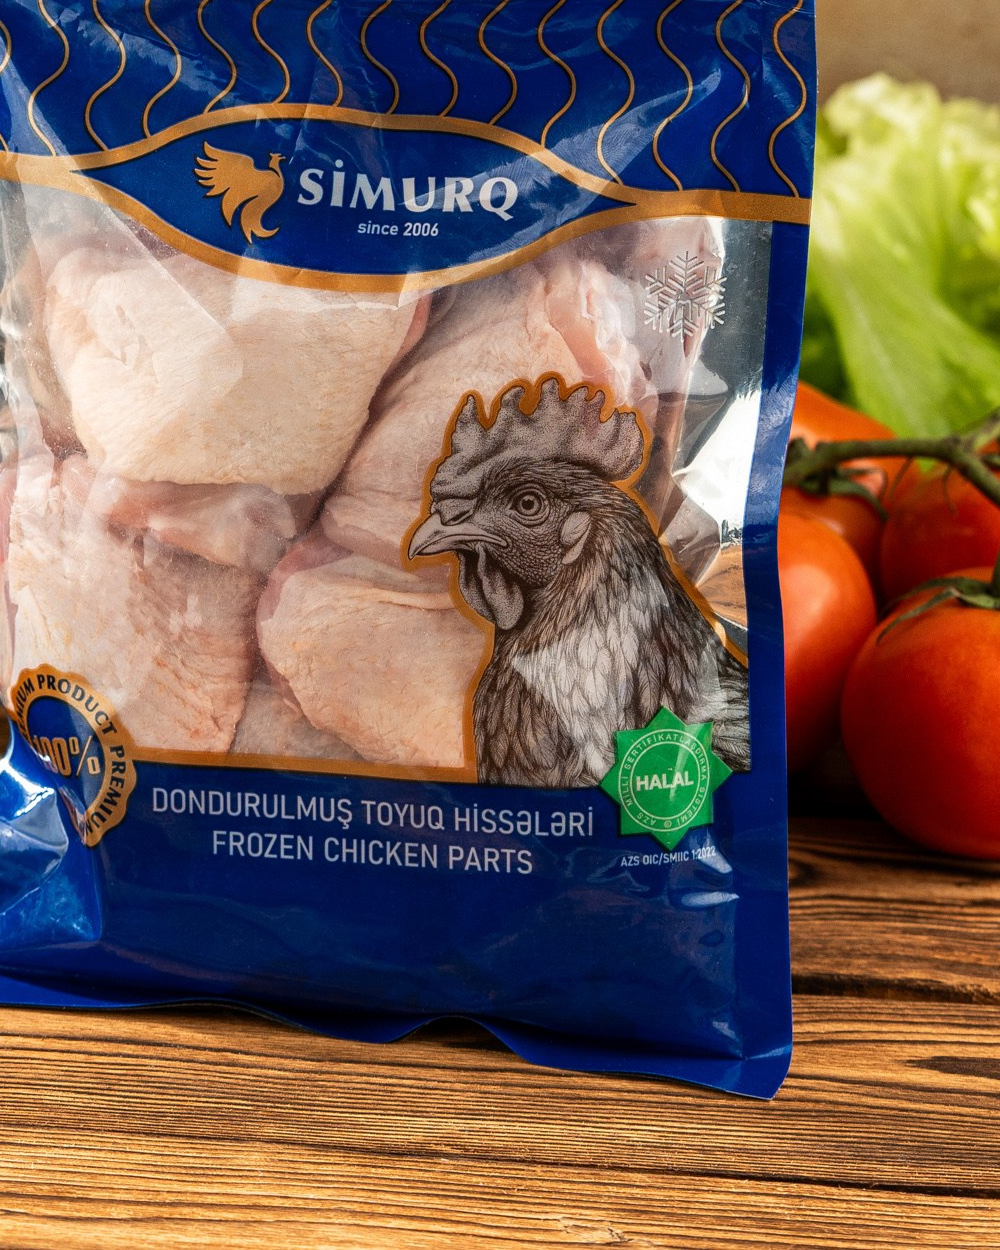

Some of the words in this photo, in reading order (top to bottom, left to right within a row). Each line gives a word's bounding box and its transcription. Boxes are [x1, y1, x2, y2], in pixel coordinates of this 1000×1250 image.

[297, 159, 519, 221] SİMURQ
[357, 220, 399, 236] since
[402, 222, 439, 237] 2006
[37, 674, 118, 735] PRODUCT
[635, 771, 694, 791] HALAL
[152, 787, 352, 829] DONDURULMUŞ
[360, 800, 445, 830] TOYUQ
[454, 803, 593, 837] HİSSƏLƏRİ
[212, 830, 313, 860] FROZEN
[324, 837, 438, 868] CHICKEN
[449, 845, 533, 874] PARTS
[620, 856, 640, 867] AZS
[642, 851, 689, 865] OIC/SMIIC
[691, 846, 716, 860] 1:2022
